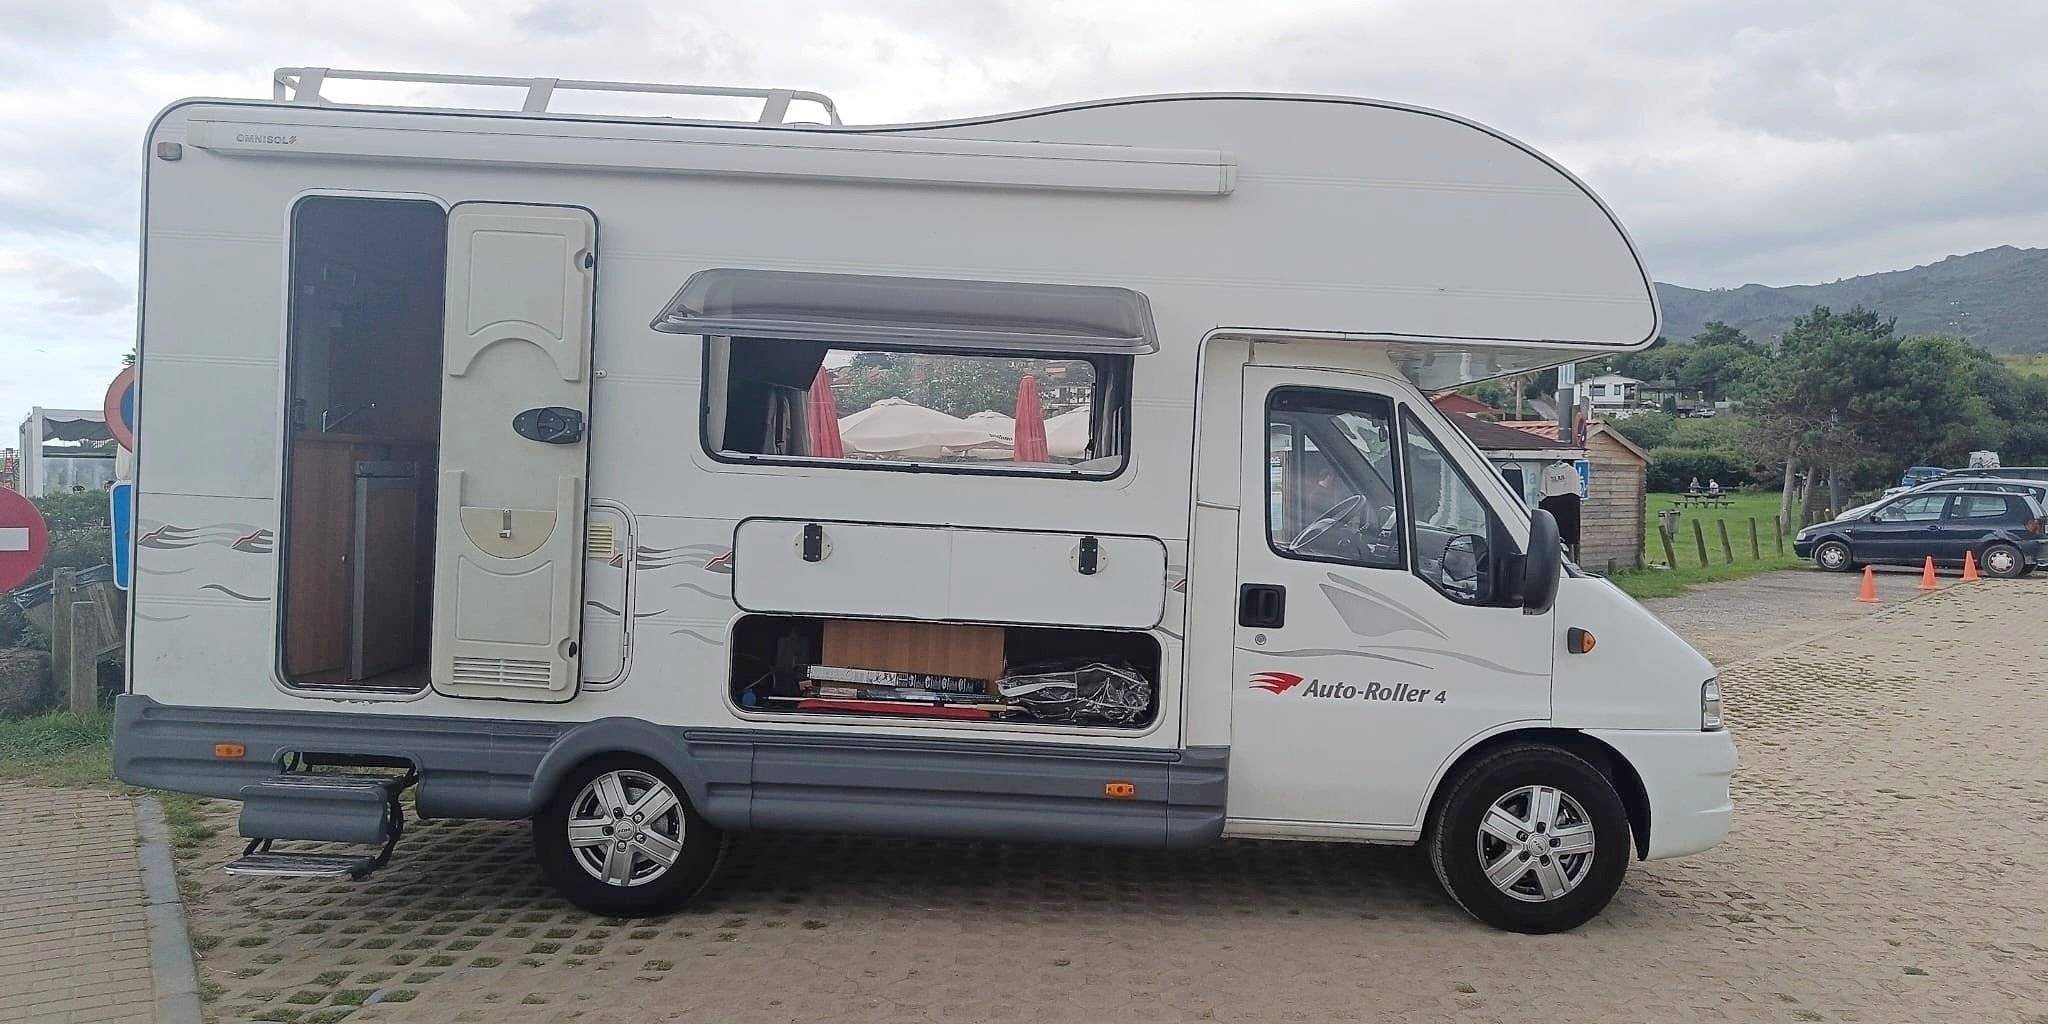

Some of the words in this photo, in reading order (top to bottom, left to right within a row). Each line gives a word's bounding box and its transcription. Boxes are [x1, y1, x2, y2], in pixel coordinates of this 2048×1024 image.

[236, 134, 289, 145] OMNISOL
[1302, 679, 1431, 703] Auto-Roller
[1434, 690, 1447, 704] 4
